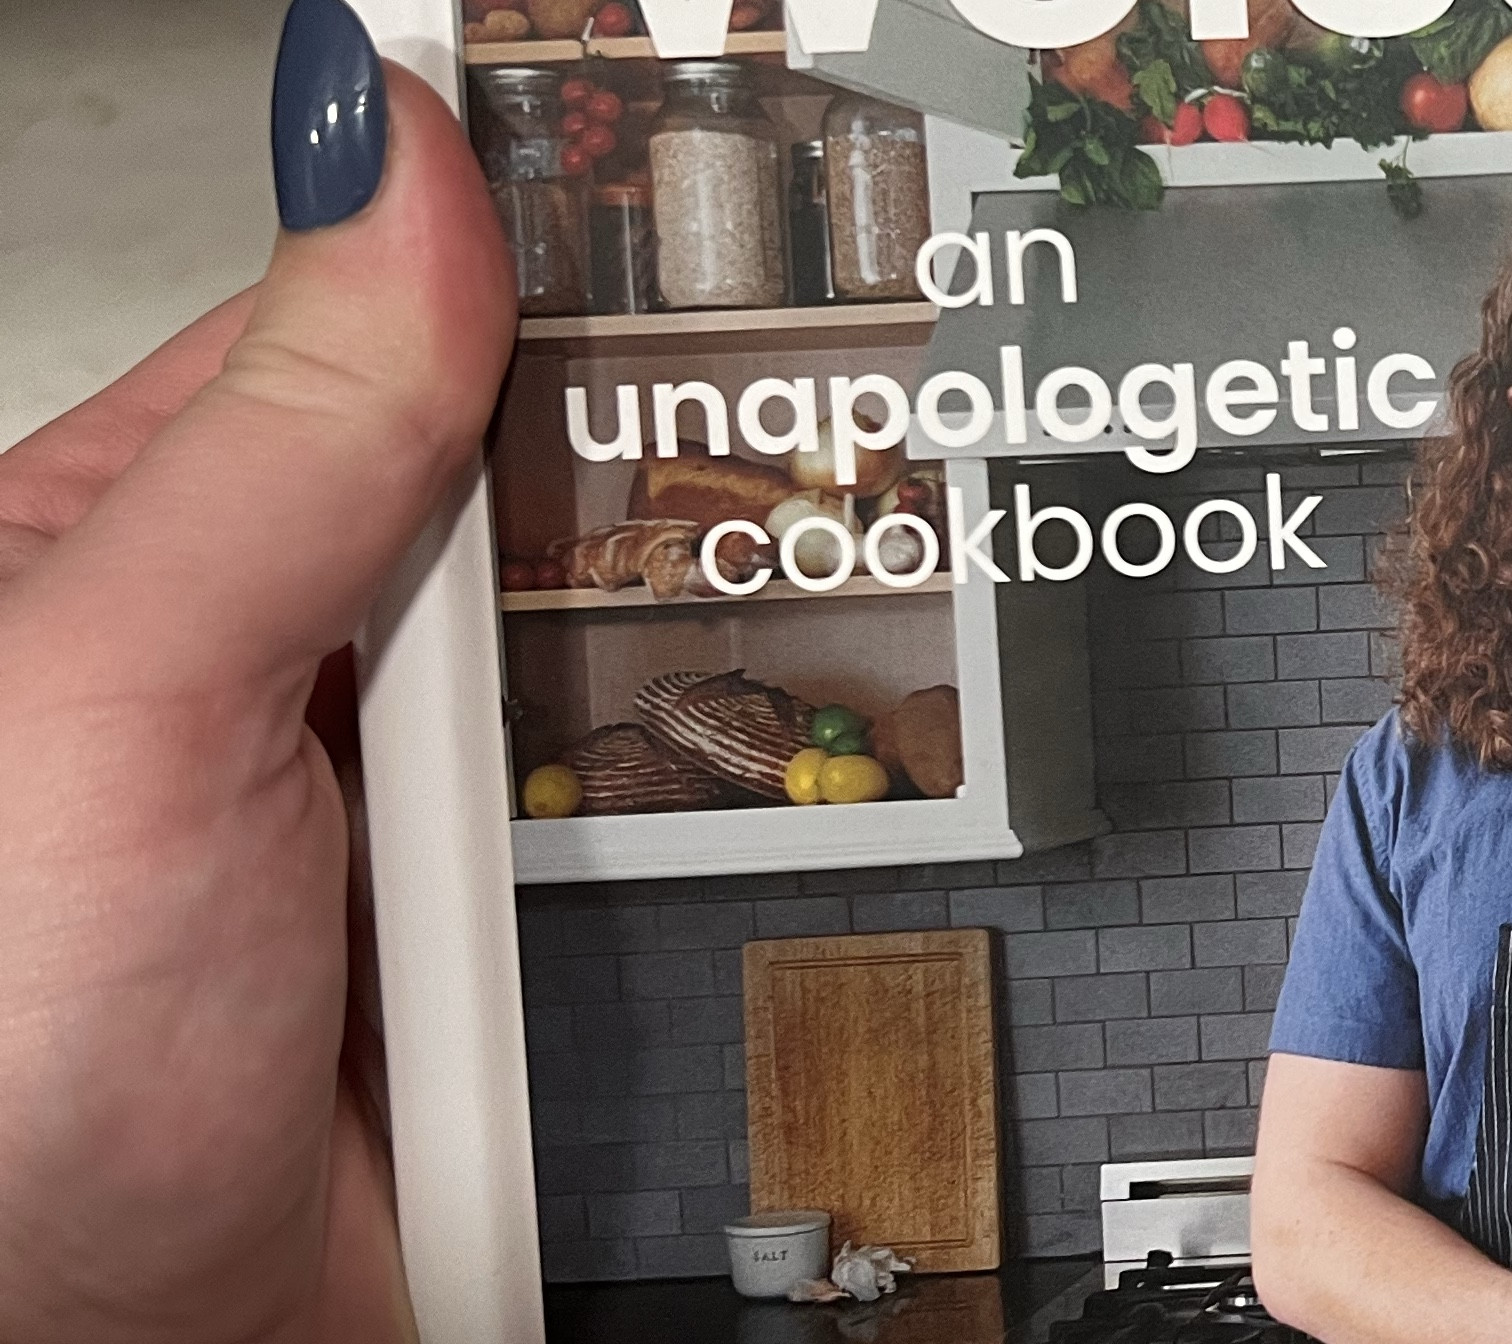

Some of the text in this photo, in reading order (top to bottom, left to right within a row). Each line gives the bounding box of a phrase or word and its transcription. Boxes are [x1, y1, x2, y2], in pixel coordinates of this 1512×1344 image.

[914, 225, 1079, 309] an
[564, 326, 1438, 486] unapologetic
[700, 472, 1328, 596] cookbook
[753, 1249, 788, 1262] SALT
